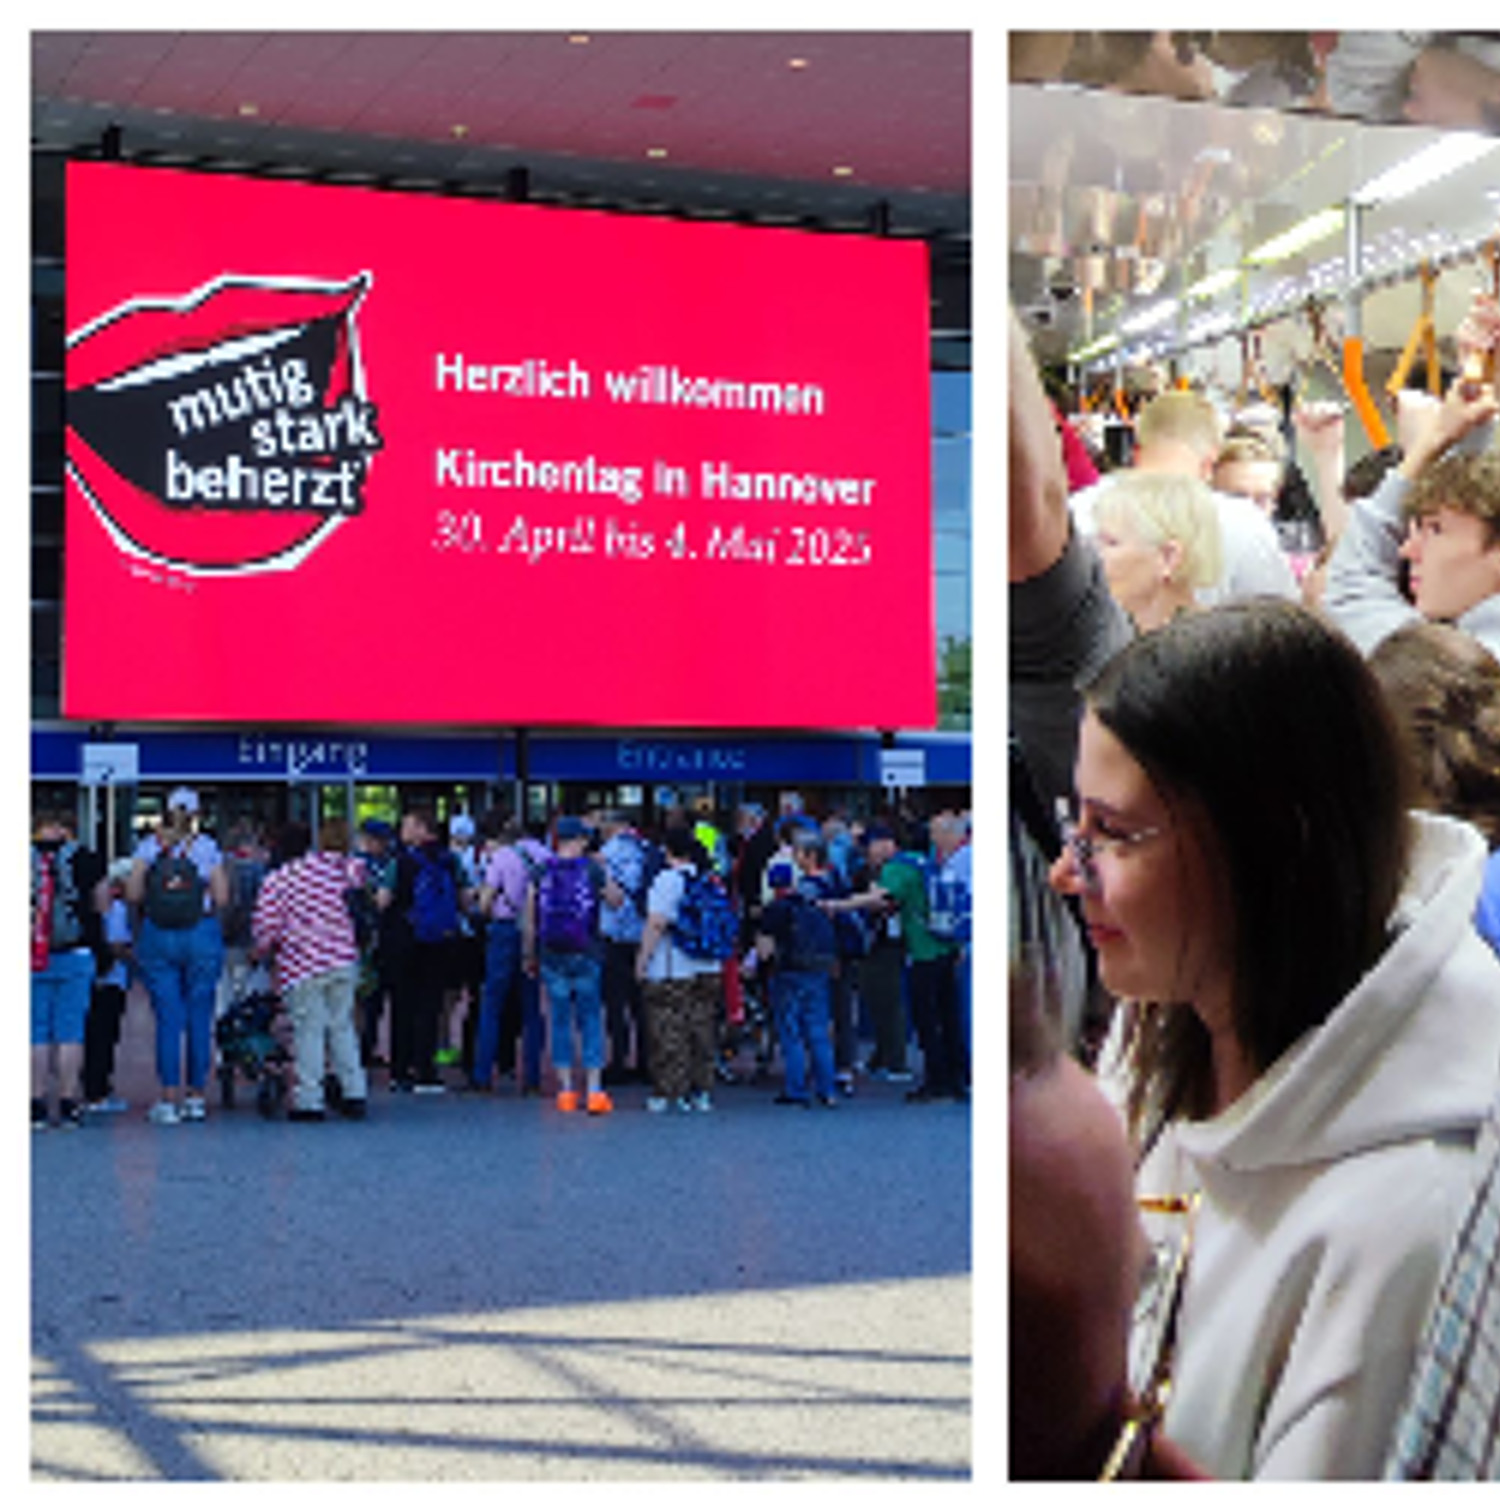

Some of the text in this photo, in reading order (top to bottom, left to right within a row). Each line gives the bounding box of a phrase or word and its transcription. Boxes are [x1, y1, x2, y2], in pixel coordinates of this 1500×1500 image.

[167, 354, 314, 436] mutig
[434, 352, 825, 416] Herzlich willkommen
[250, 399, 380, 458] stark
[434, 447, 877, 506] Kirchentag in Hannover
[432, 508, 872, 567] 30. April bis 4. Mai 2025
